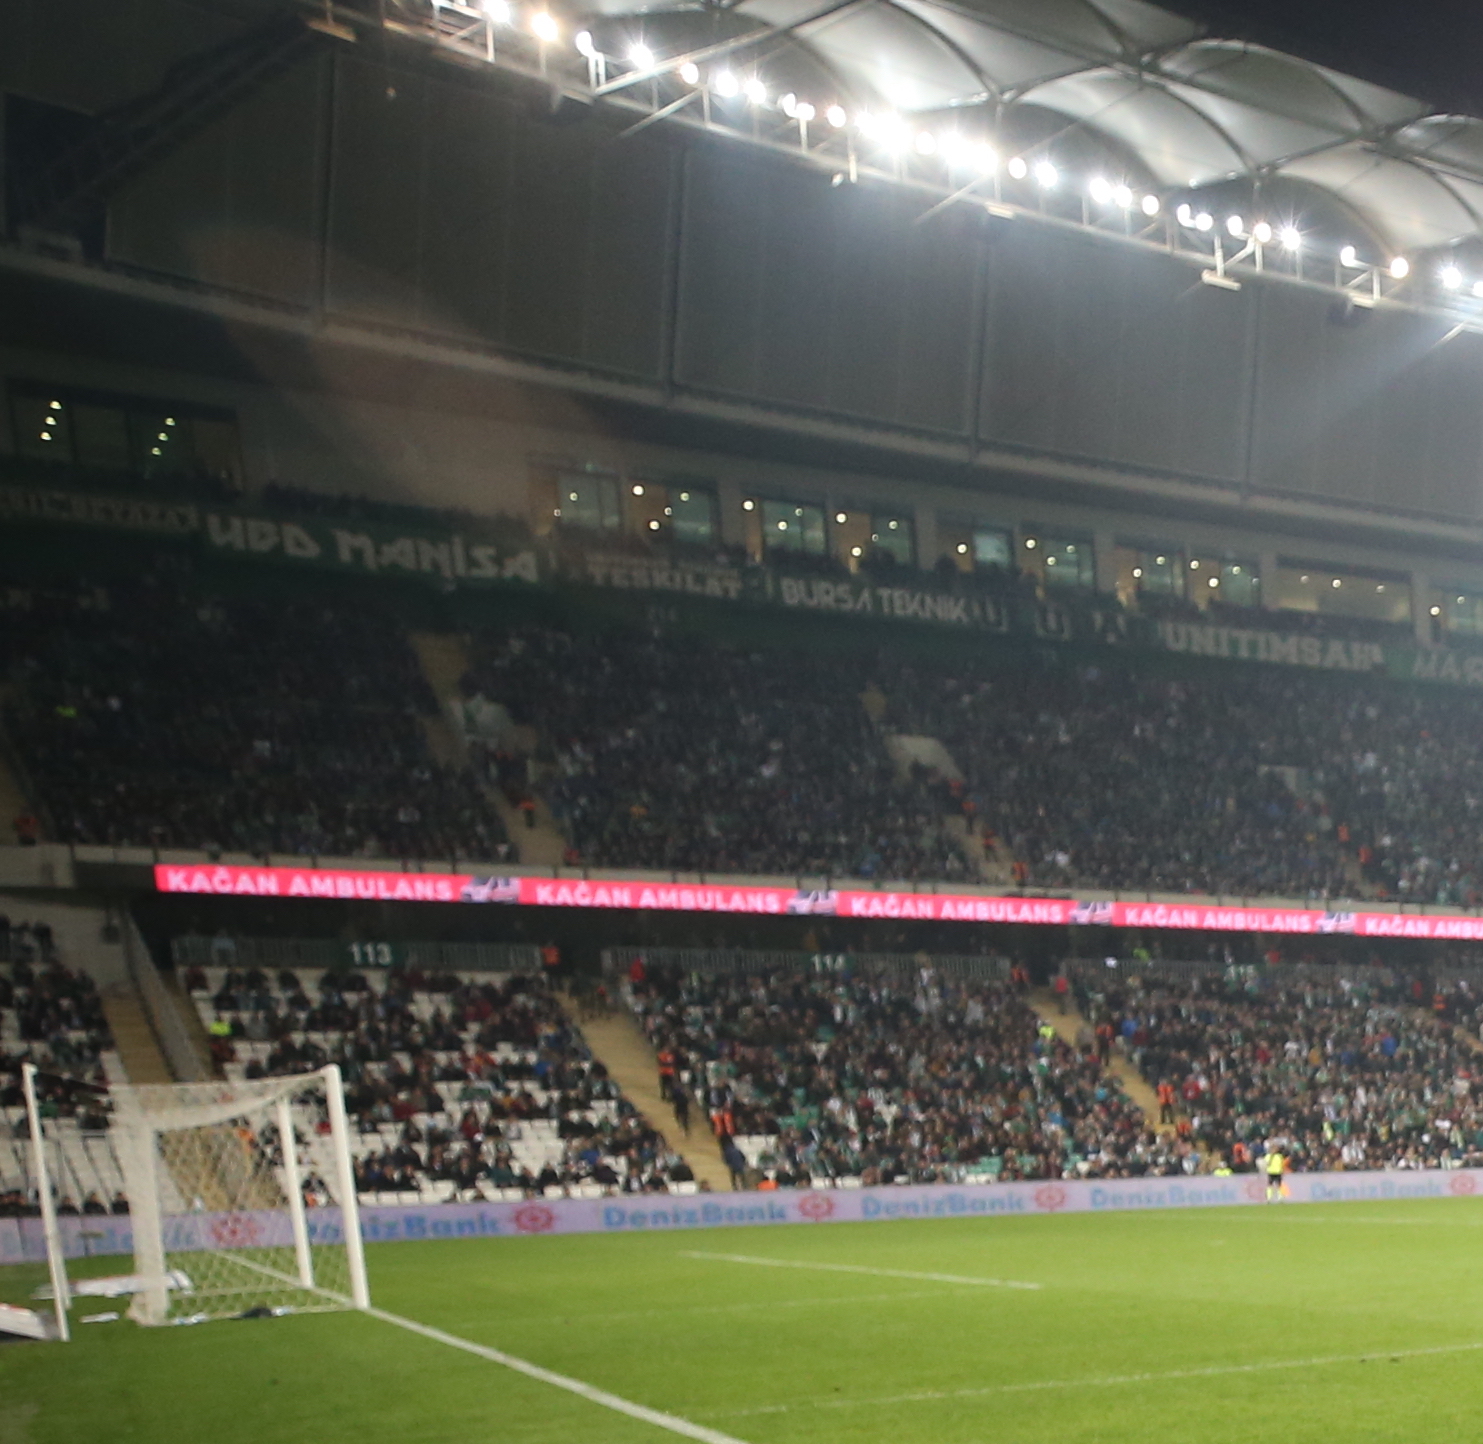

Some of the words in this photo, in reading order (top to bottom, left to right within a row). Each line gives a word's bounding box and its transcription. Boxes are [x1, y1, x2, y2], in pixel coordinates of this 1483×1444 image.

[289, 873, 454, 900] AMBULANS
[639, 886, 781, 913] AMBULANS
[940, 900, 1063, 924] AMBULANS
[1203, 910, 1312, 932] AMBULANS
[350, 941, 393, 966] 113
[603, 1201, 787, 1228] DenizBank
[861, 1191, 1025, 1218] DenizBank
